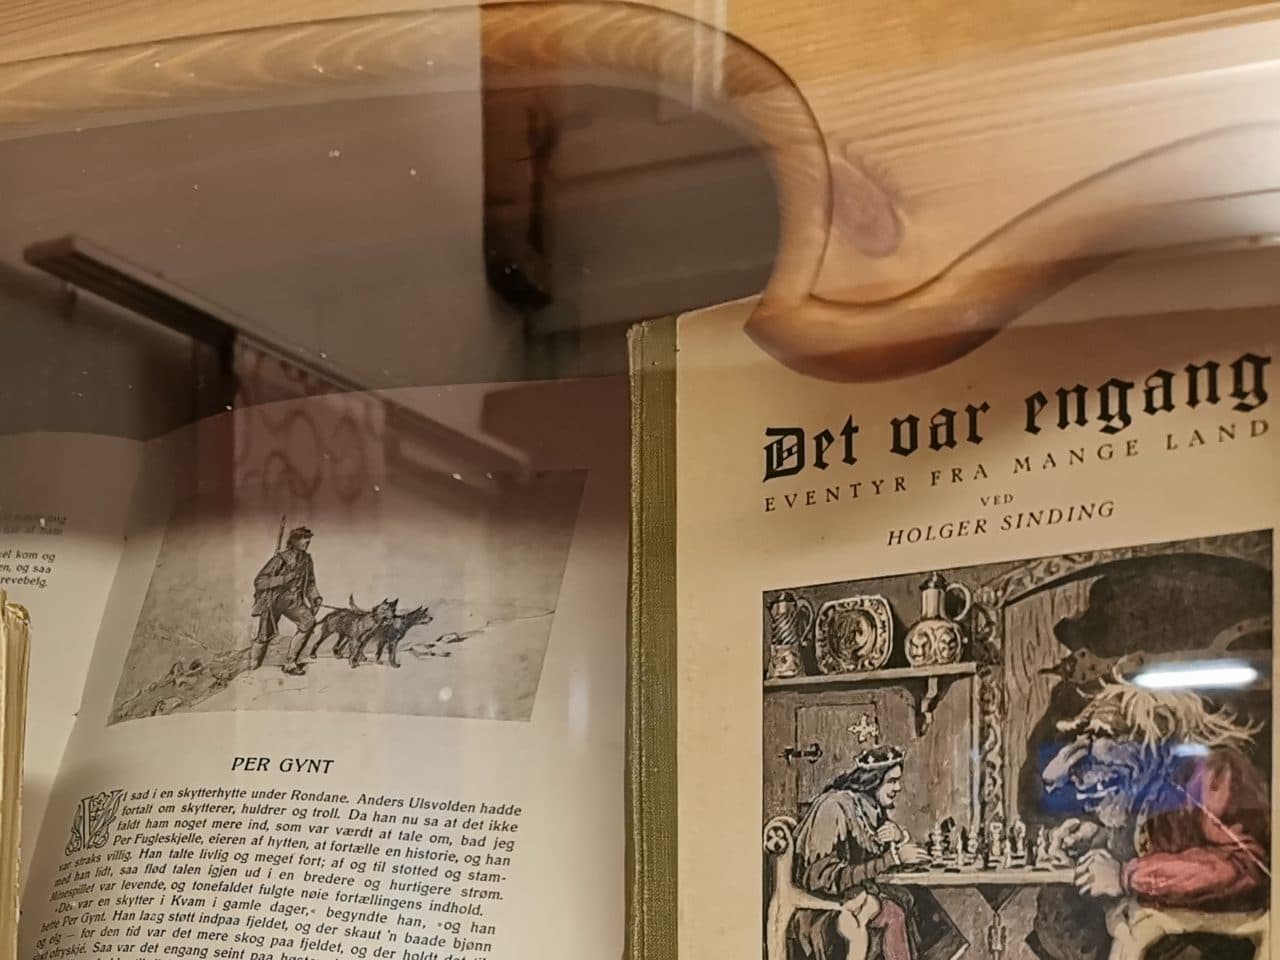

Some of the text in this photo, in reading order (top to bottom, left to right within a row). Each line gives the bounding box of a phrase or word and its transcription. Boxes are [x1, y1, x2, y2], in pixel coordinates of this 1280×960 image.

[762, 351, 1271, 483] Det var engang
[765, 418, 1270, 512] EVENTYR FRA MANGE LAND
[980, 493, 1013, 508] VED
[887, 500, 1116, 546] HOLGER SINDING
[231, 757, 334, 774] PER GYNT
[121, 803, 518, 833] fortalt om skytterer, huldrer og troll. Da han nu sa at det ikke
[130, 790, 149, 800] sad
[159, 790, 174, 799] en
[177, 787, 247, 800] skytterhytte
[251, 788, 287, 800] under
[291, 789, 350, 803] Rondane.
[357, 793, 404, 808] Anders
[409, 797, 475, 813] Ulsvolden
[480, 802, 522, 816] hadde
[113, 833, 511, 867] Per Fugleskjelle, eieren af hytten, at fortælle en historie, og han
[117, 818, 515, 852] faldt ham noget mere ind, som var værdt at tale om, bad jeg
